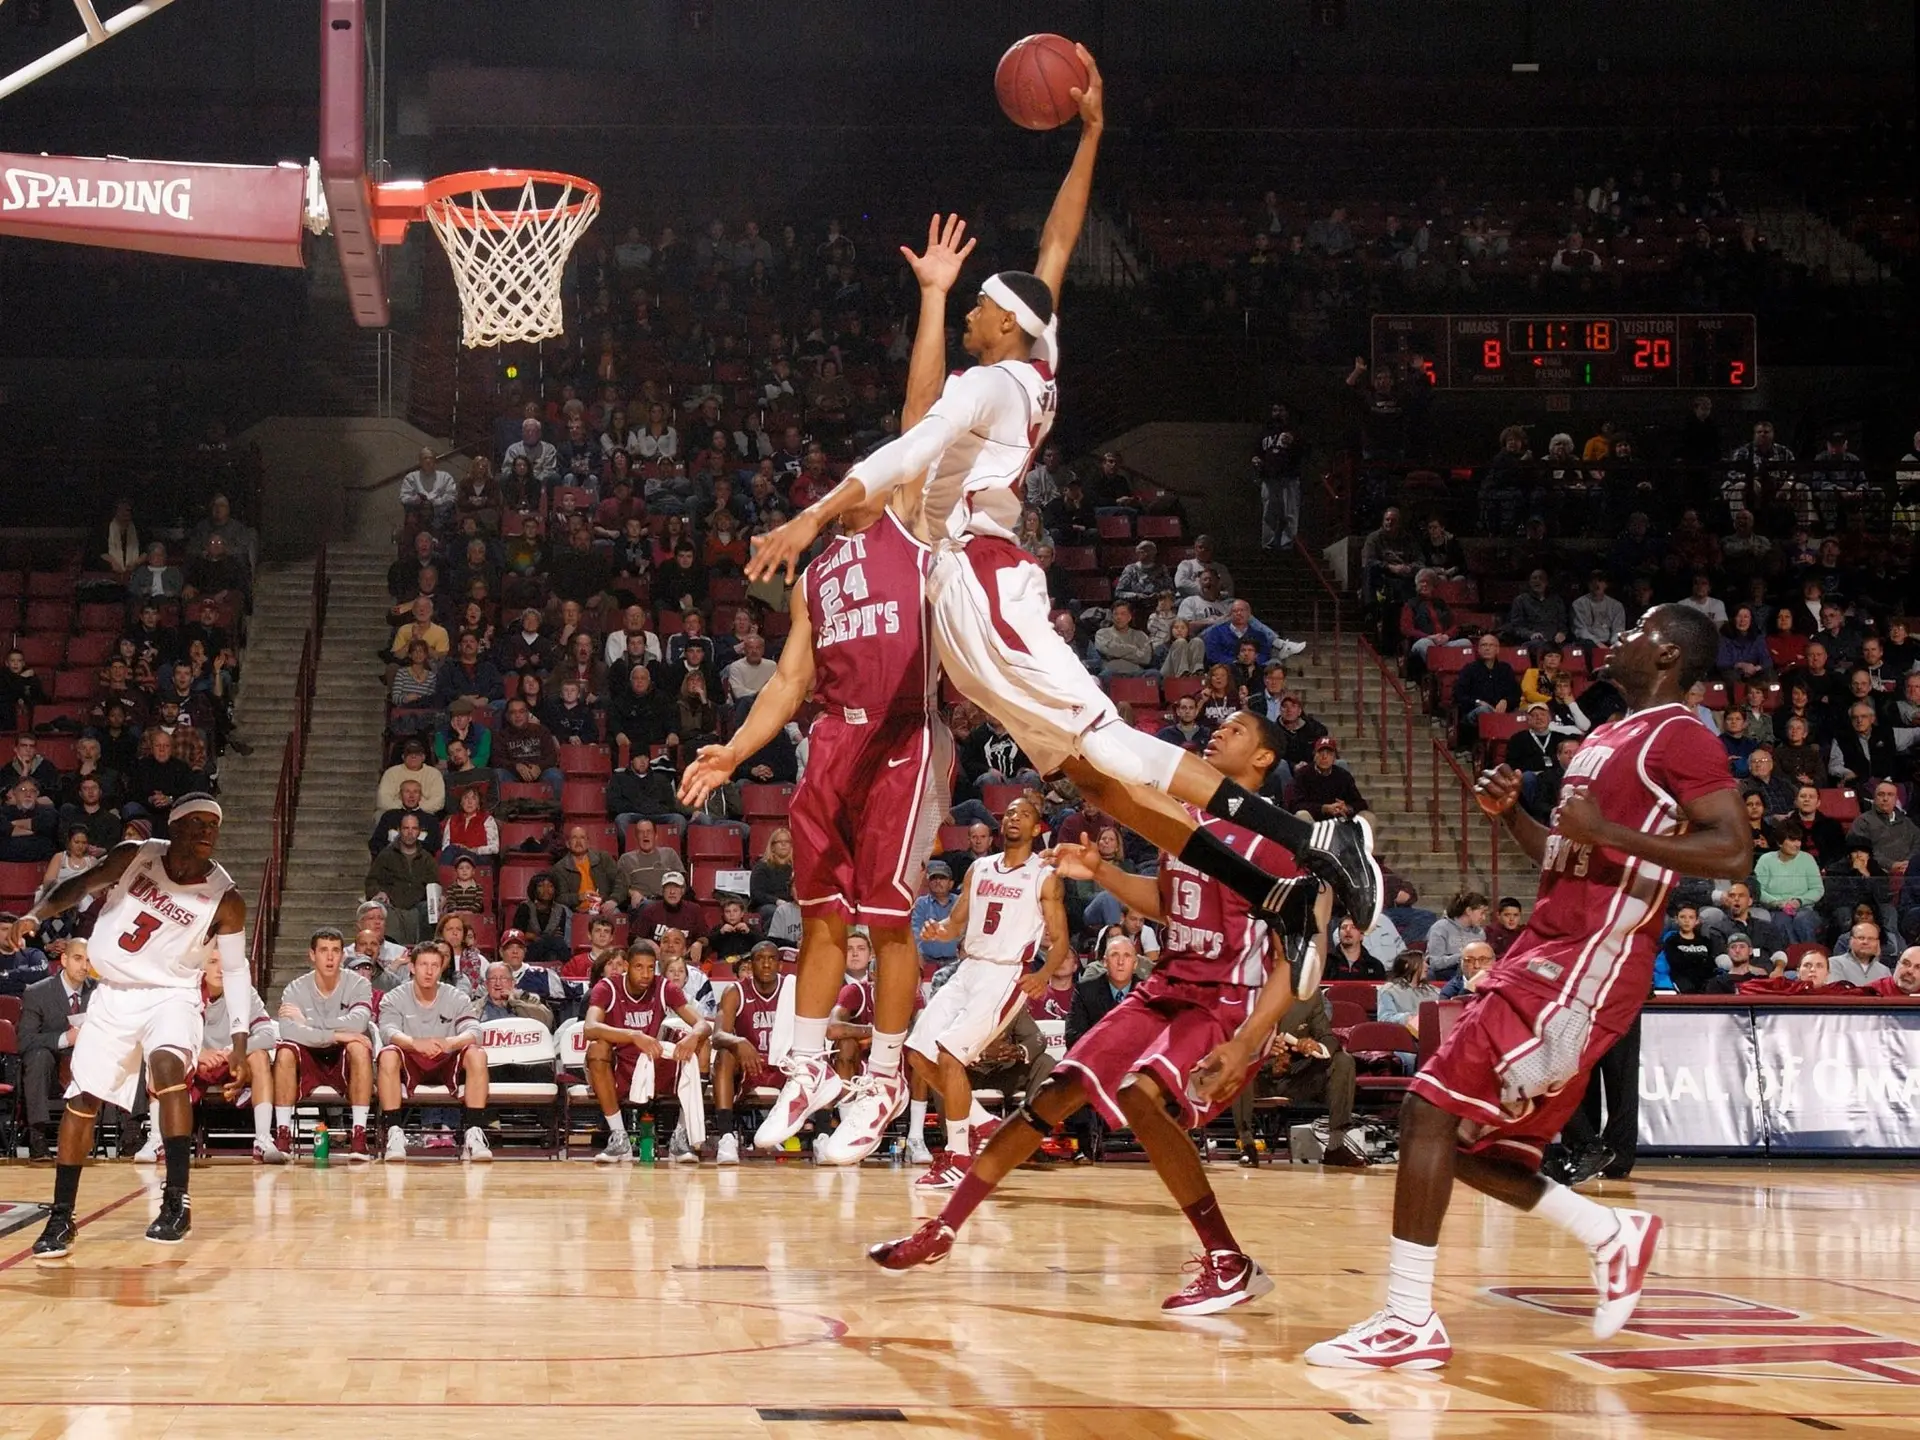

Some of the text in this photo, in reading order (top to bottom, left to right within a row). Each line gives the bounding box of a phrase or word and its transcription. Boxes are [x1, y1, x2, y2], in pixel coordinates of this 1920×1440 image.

[3, 168, 191, 220] SPALDING
[1458, 321, 1499, 334] UMASS
[1527, 321, 1611, 351] 11:18
[1622, 320, 1675, 333] VISITOR
[1483, 339, 1502, 369] 8
[1633, 338, 1672, 369] 20
[1583, 361, 1592, 385] 1
[1729, 360, 1746, 385] 2
[819, 563, 869, 616] 24
[1172, 877, 1201, 920] 13
[118, 911, 163, 953] 3
[983, 902, 1003, 935] 5
[1168, 921, 1224, 959] EPH'S
